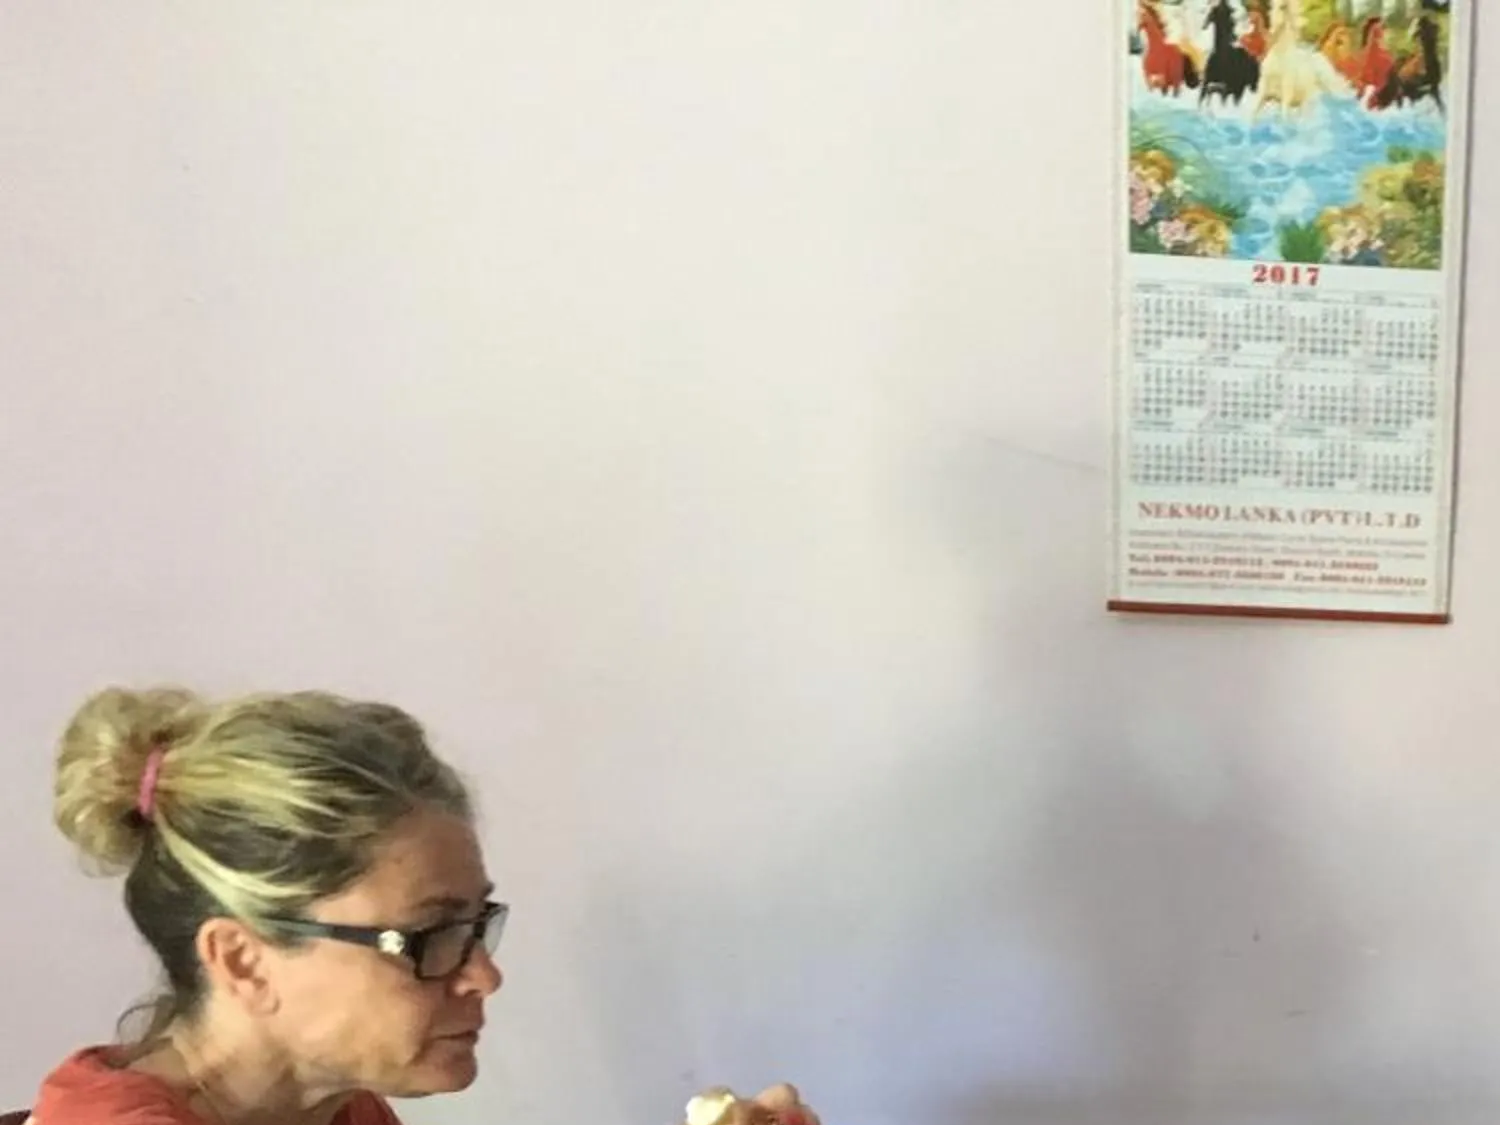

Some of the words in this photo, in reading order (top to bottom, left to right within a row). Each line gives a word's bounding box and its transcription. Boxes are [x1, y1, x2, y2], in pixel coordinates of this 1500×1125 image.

[1252, 263, 1321, 286] 2017
[1138, 501, 1220, 521] NEKMO
[1223, 504, 1296, 524] LANKA
